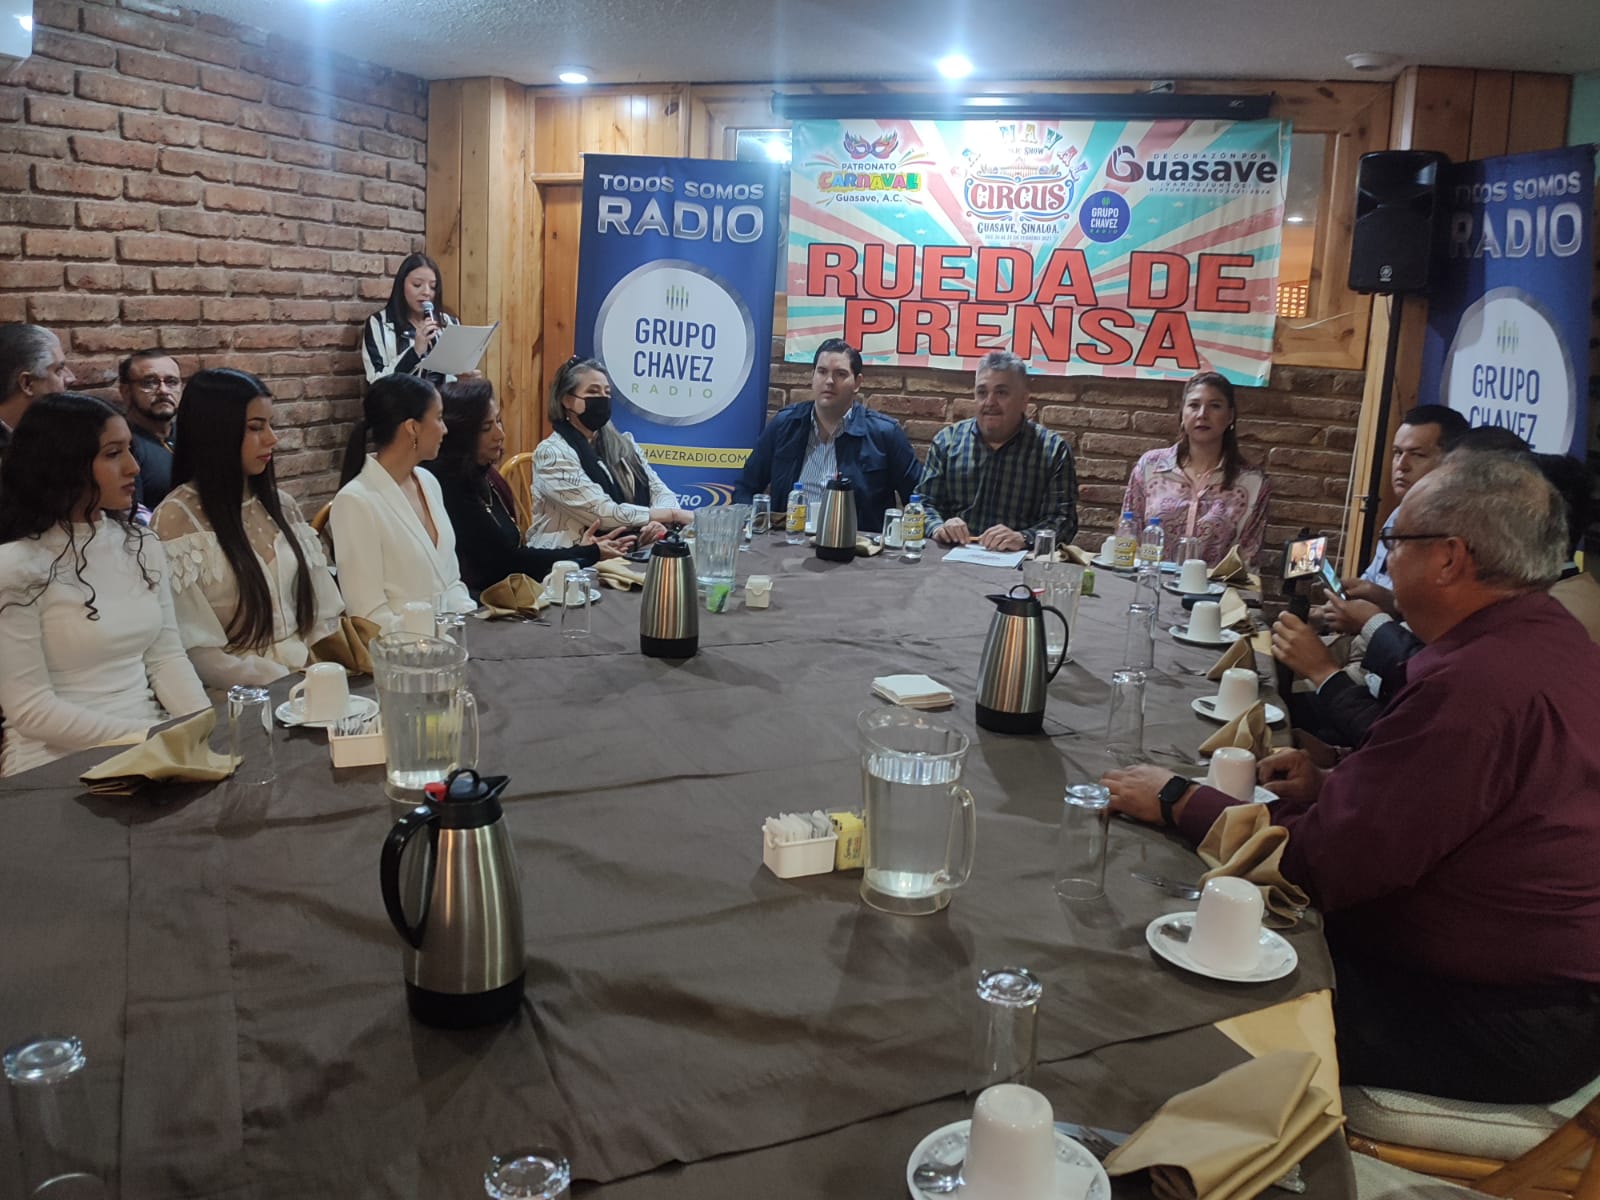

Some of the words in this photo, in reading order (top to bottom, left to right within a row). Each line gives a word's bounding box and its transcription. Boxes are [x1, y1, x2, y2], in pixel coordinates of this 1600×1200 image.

[841, 162, 897, 170] PATRONATO
[1173, 151, 1237, 160] CORAZÓN
[1241, 152, 1267, 160] POR
[598, 174, 675, 193] TODOS
[684, 181, 764, 200] SOMOS
[818, 171, 921, 192] CARNAVAL
[1512, 170, 1582, 201] SOMOS
[835, 193, 880, 203] Guasave,
[882, 194, 903, 203] A.C.
[970, 183, 1066, 211] CIRCUS
[597, 195, 764, 243] RADIO
[1090, 218, 1119, 229] CHAVEZ
[1091, 207, 1119, 218] GRUPO
[977, 222, 1017, 235] GUASAVE,
[1021, 222, 1060, 235] SINALOA.
[1450, 202, 1583, 258] RADIO
[806, 243, 1098, 307] RUEDA
[1126, 249, 1255, 314] DE
[635, 318, 716, 350] GRUPO
[843, 297, 1201, 369] PRENSA
[633, 351, 714, 382] CHAVEZ
[631, 383, 713, 399] RADIO
[1472, 363, 1540, 405] GRUPO
[644, 448, 747, 464] HAVEZRADIO.COM
